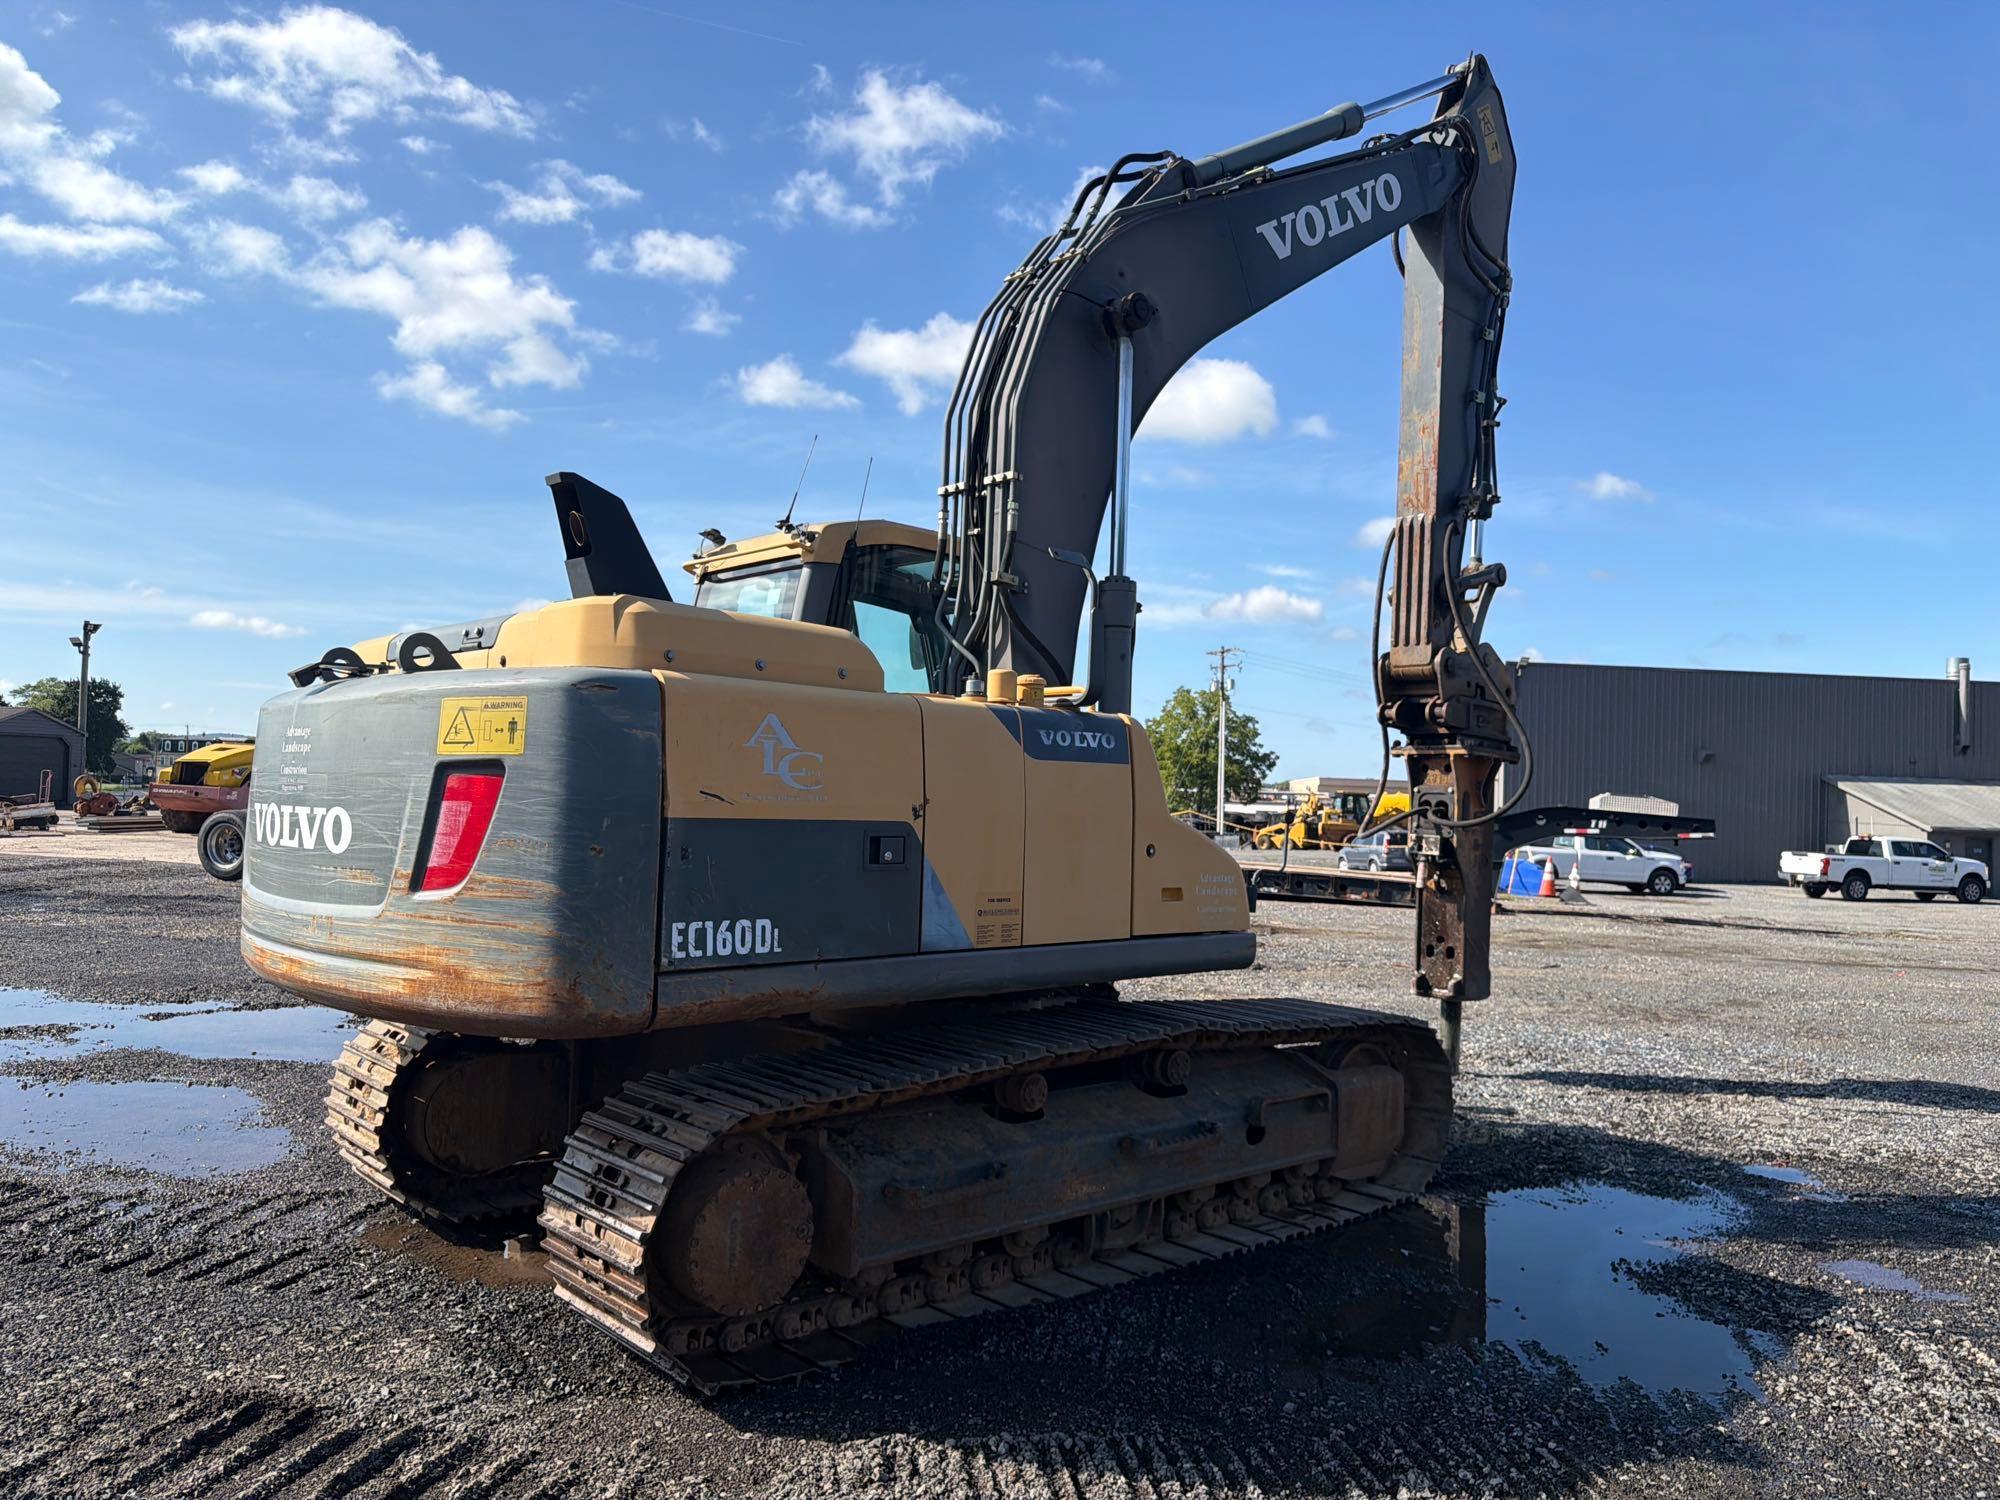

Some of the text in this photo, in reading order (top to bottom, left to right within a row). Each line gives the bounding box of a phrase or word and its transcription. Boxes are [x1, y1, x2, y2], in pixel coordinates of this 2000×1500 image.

[1256, 172, 1402, 260] VOLVO
[490, 701, 524, 710] WARNING
[282, 741, 312, 756] Landscape
[1038, 729, 1116, 749] VOLVO
[254, 802, 352, 854] VOLVO
